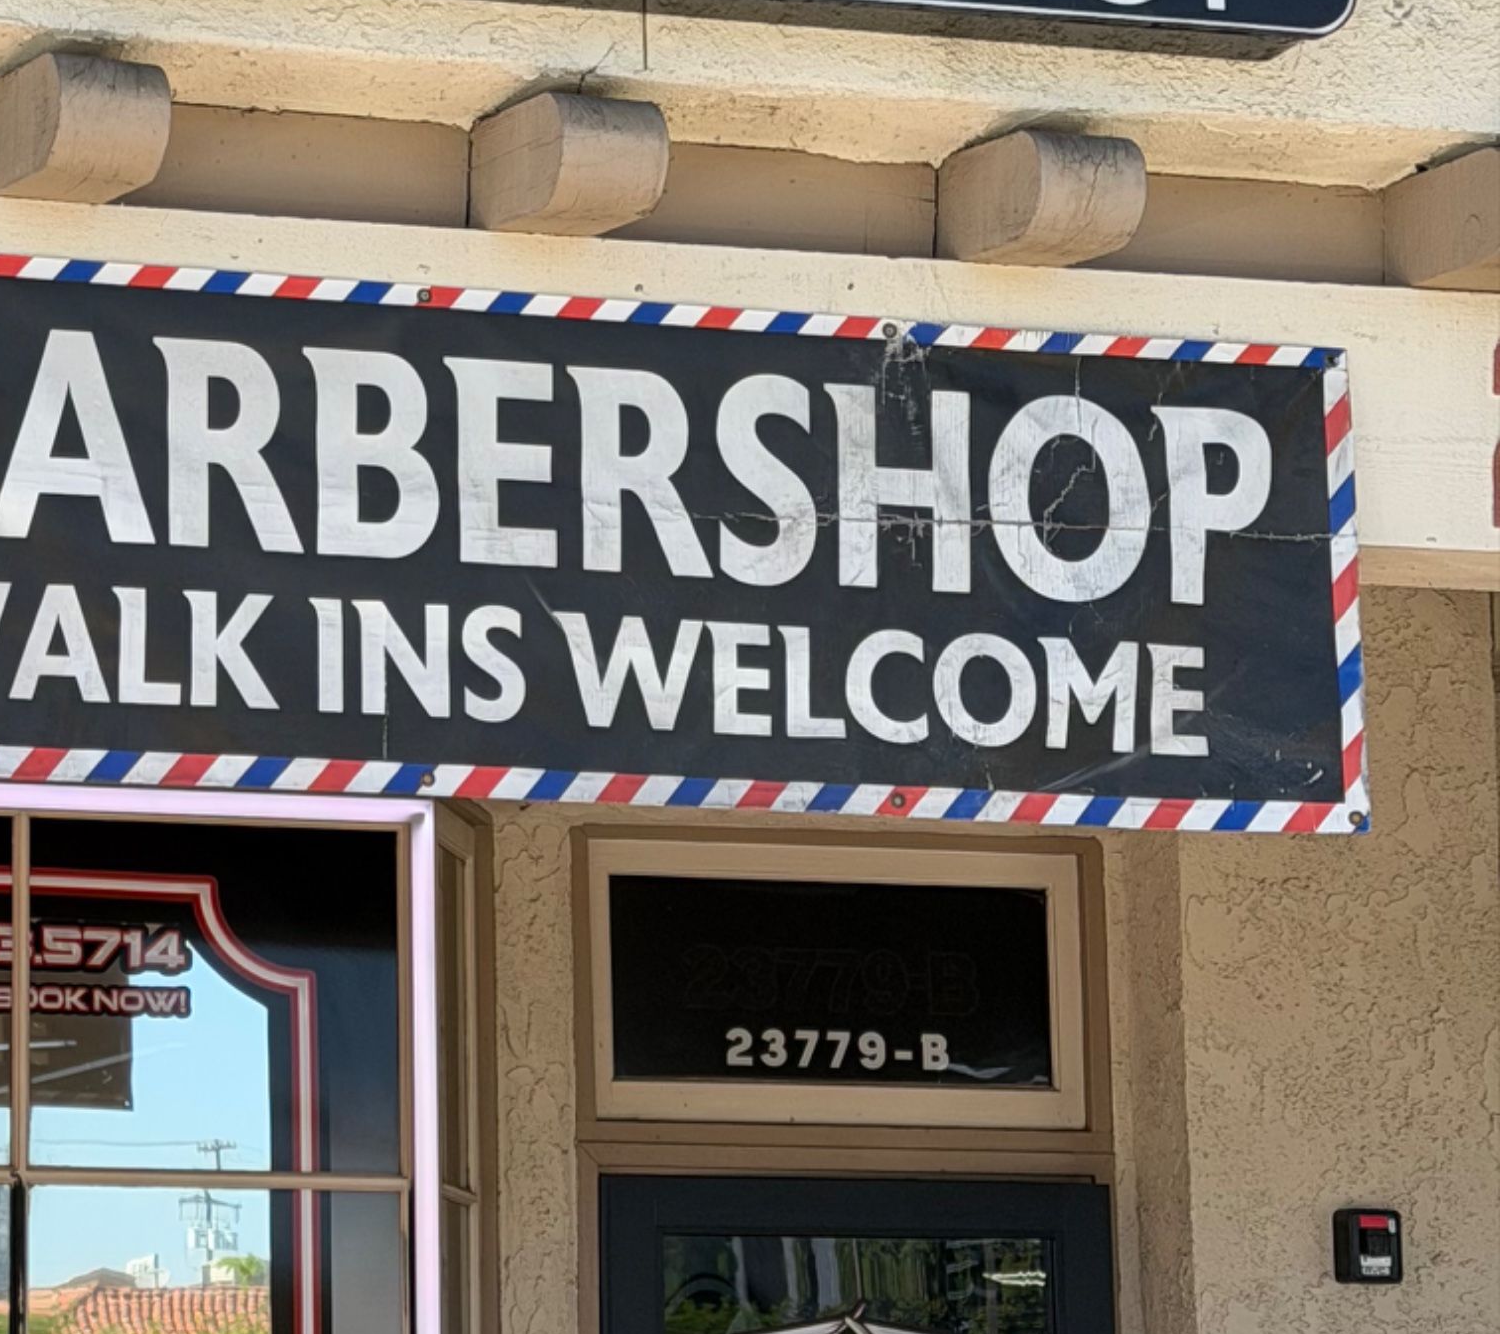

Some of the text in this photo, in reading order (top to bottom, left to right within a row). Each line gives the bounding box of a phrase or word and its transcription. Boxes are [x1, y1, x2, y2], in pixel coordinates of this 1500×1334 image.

[307, 599, 526, 725] INS
[550, 609, 1210, 759] WELCOME
[93, 988, 189, 1013] NOW!
[725, 1027, 950, 1072] 23779-B
